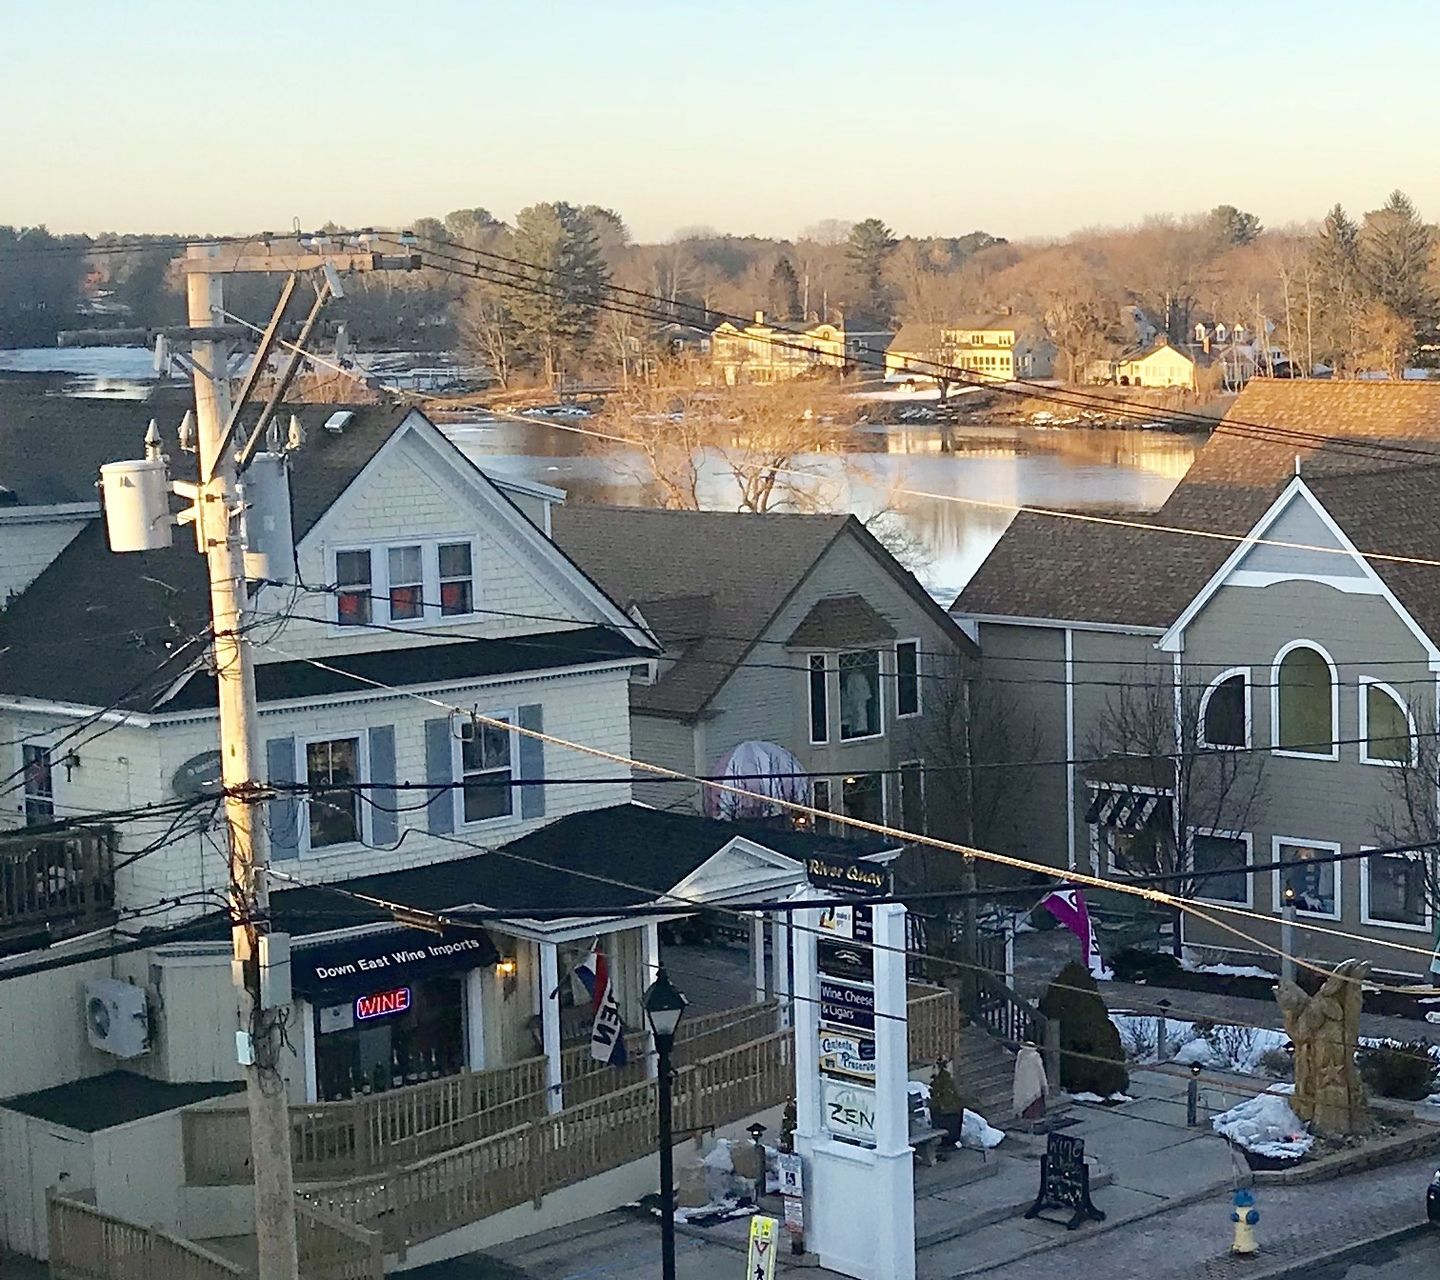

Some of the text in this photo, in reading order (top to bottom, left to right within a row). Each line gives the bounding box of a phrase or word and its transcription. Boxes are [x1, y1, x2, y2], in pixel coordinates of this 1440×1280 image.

[809, 859, 882, 888] River Quay
[315, 938, 480, 979] Down East Wine Imports
[359, 991, 407, 1016] WINE
[845, 991, 874, 1007] Cheese
[829, 1005, 854, 1020] Cigars
[828, 1102, 875, 1130] ZEN
